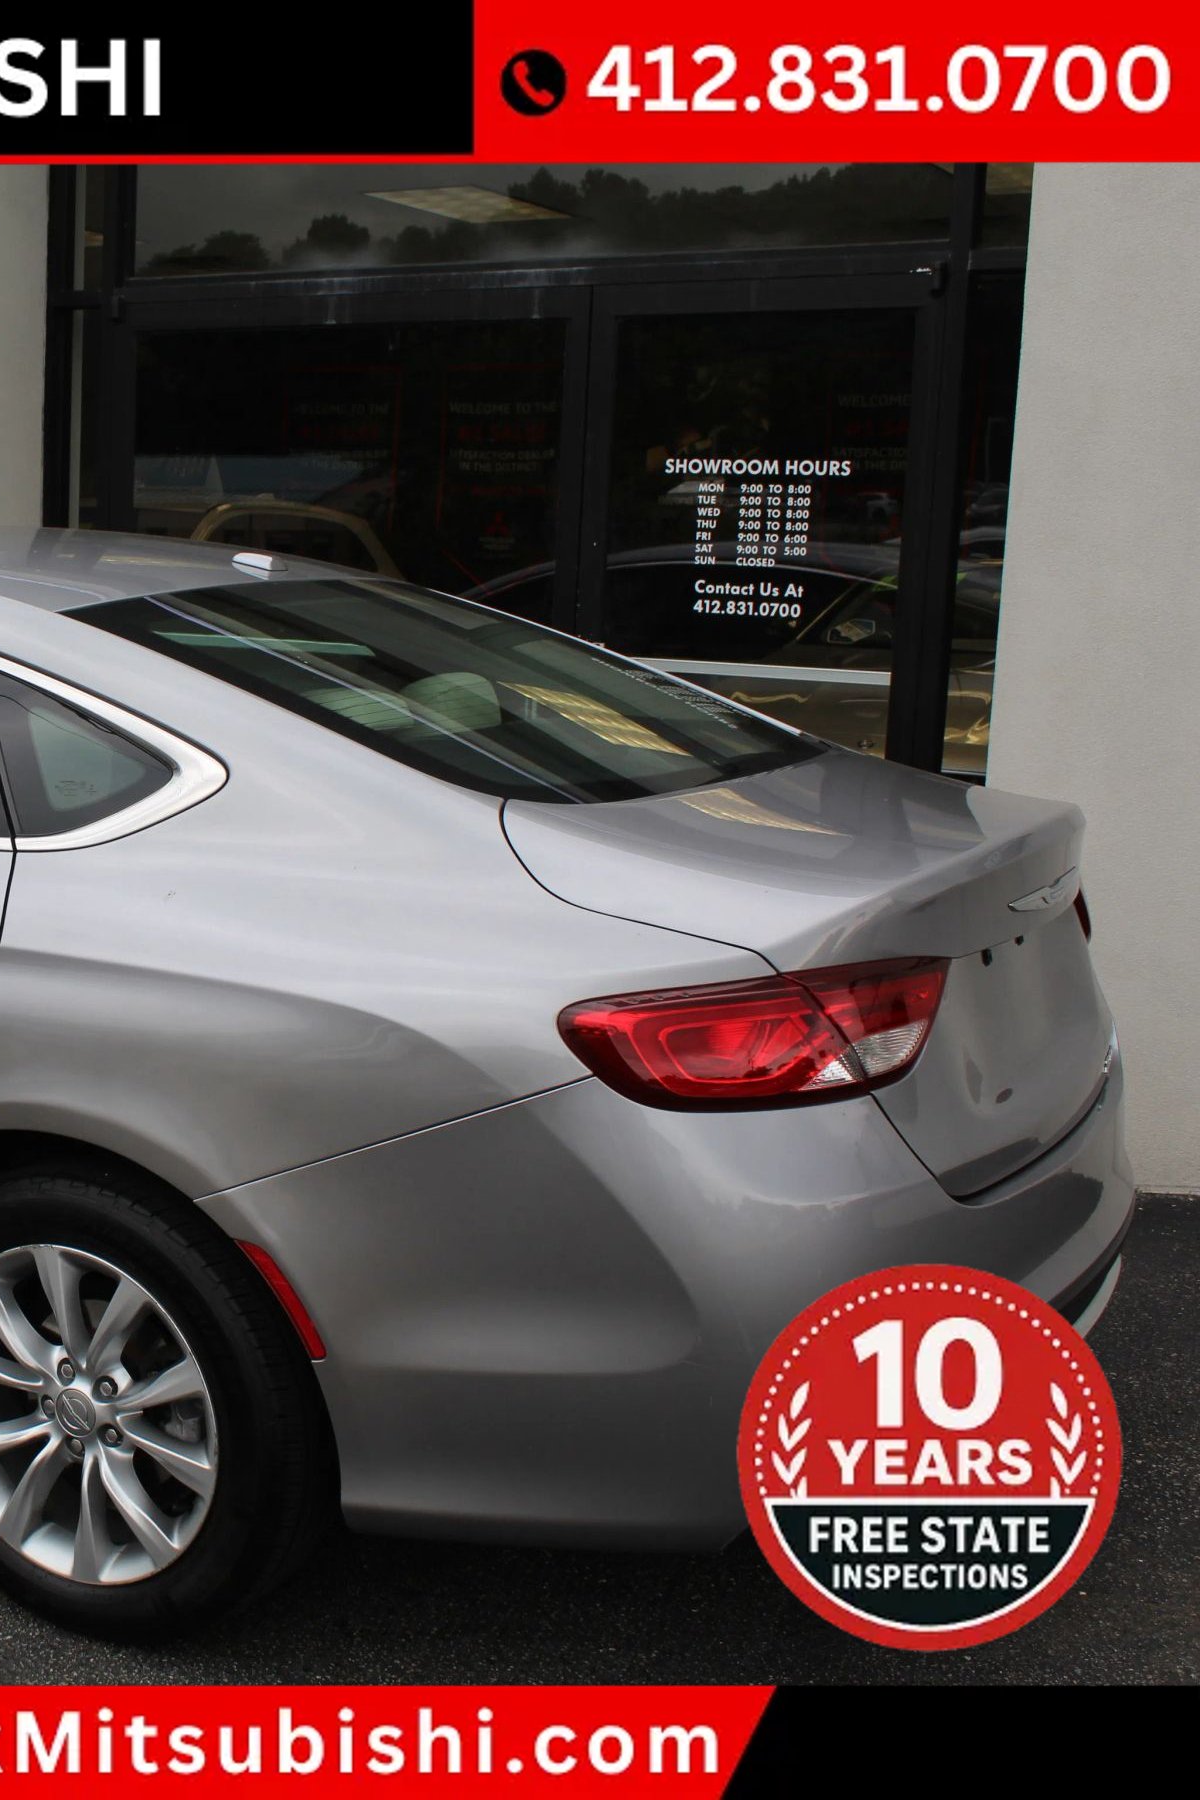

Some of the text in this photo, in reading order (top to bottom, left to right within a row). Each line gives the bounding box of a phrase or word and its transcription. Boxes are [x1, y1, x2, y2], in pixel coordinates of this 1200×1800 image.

[449, 402, 511, 414] WELCOME
[516, 402, 530, 414] TO
[665, 458, 852, 477] SHOWROOM HOURS
[699, 484, 811, 494] MON 9:00 TO 8:00
[698, 496, 810, 506] TUE 9:00 TO 8:00
[698, 508, 809, 519] WED 9:00 TO 8:00
[697, 520, 808, 531] THU 9:00 TO 8:00
[696, 532, 807, 543] FRI 9:00 TO 6:00
[695, 544, 806, 556] SAT 9:00 TO 5:00
[695, 556, 775, 567] SUN CLOSED
[694, 580, 804, 598] Contact Us At
[693, 599, 801, 618] 412.831.0700
